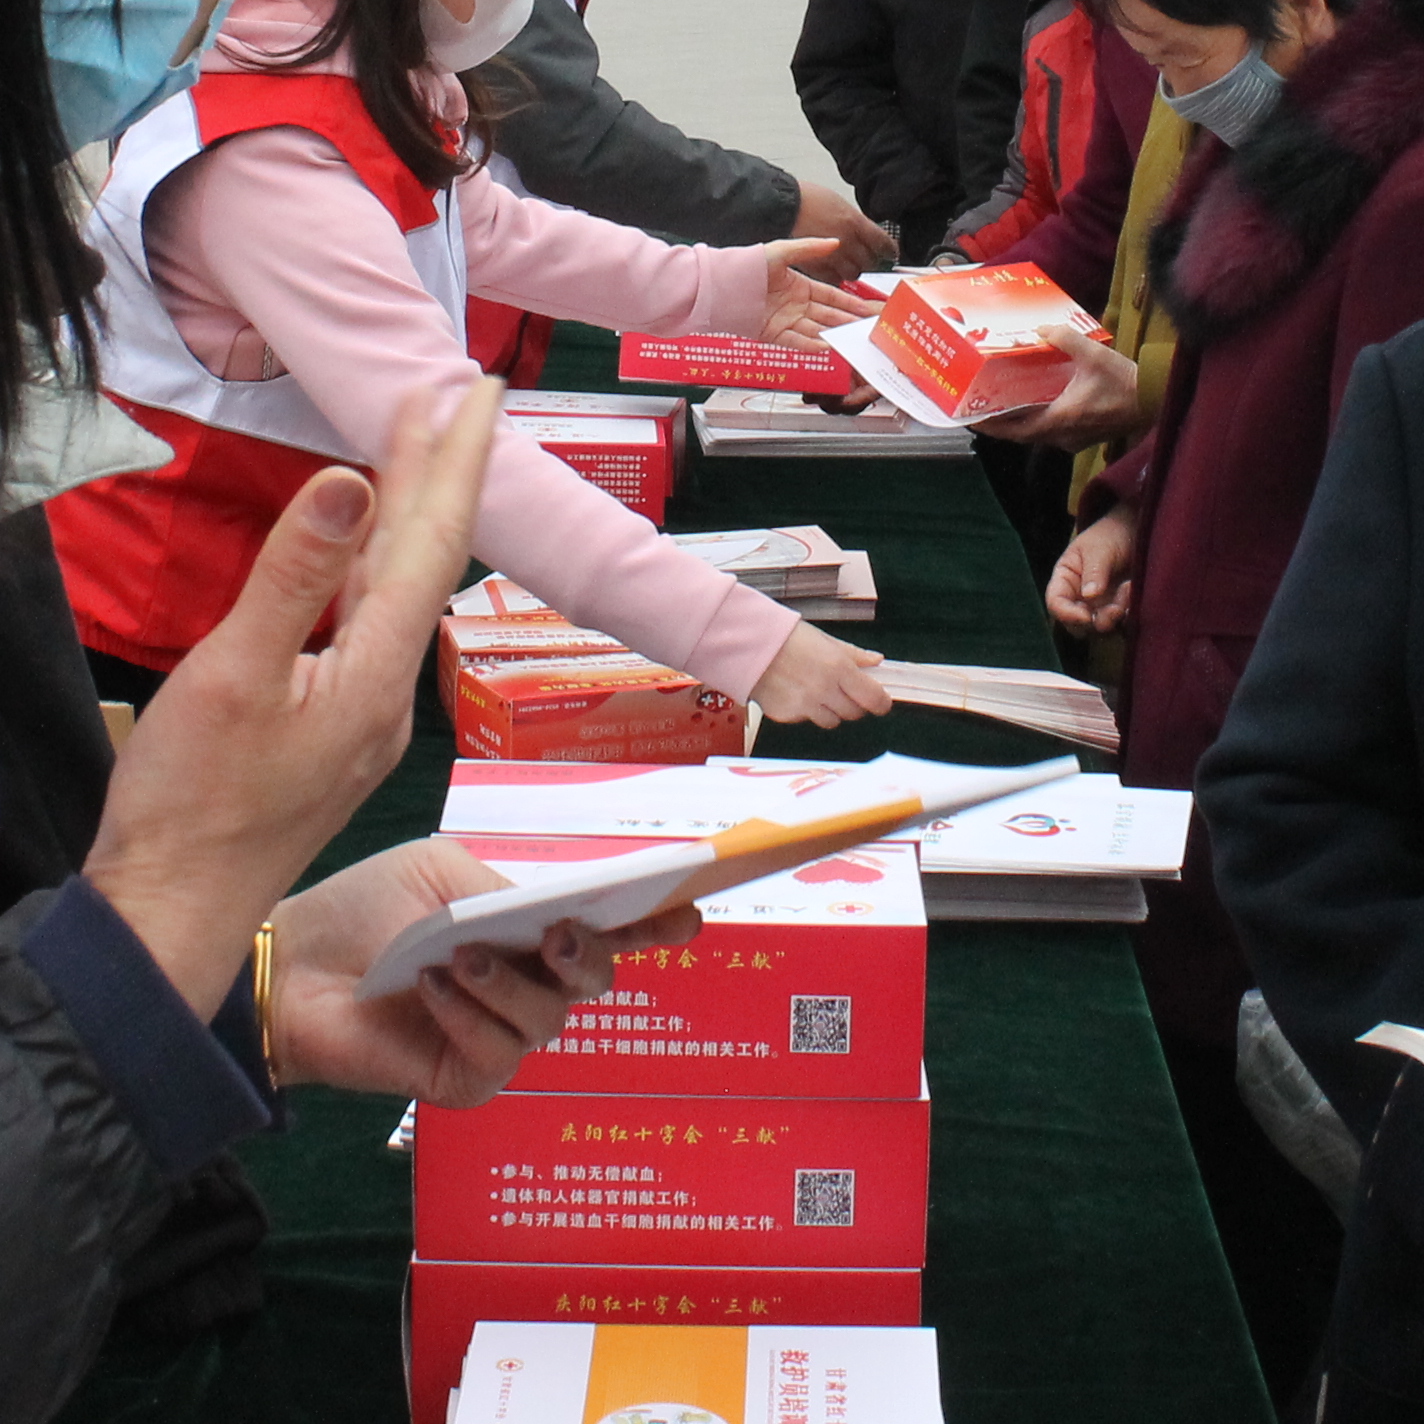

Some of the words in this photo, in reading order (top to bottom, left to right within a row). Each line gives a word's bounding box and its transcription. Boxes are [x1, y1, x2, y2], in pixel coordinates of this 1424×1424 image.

[560, 1123, 790, 1145] 庆阳红十字会“三献”
[501, 1163, 664, 1182] 参与、推动无偿献血；
[501, 1187, 698, 1207] 遗体和人体器官捐献工作；
[501, 1212, 784, 1232] 参与开展造血干细胞捐献的相关工作。
[555, 1293, 782, 1316] 庆阳红十字会“三献”
